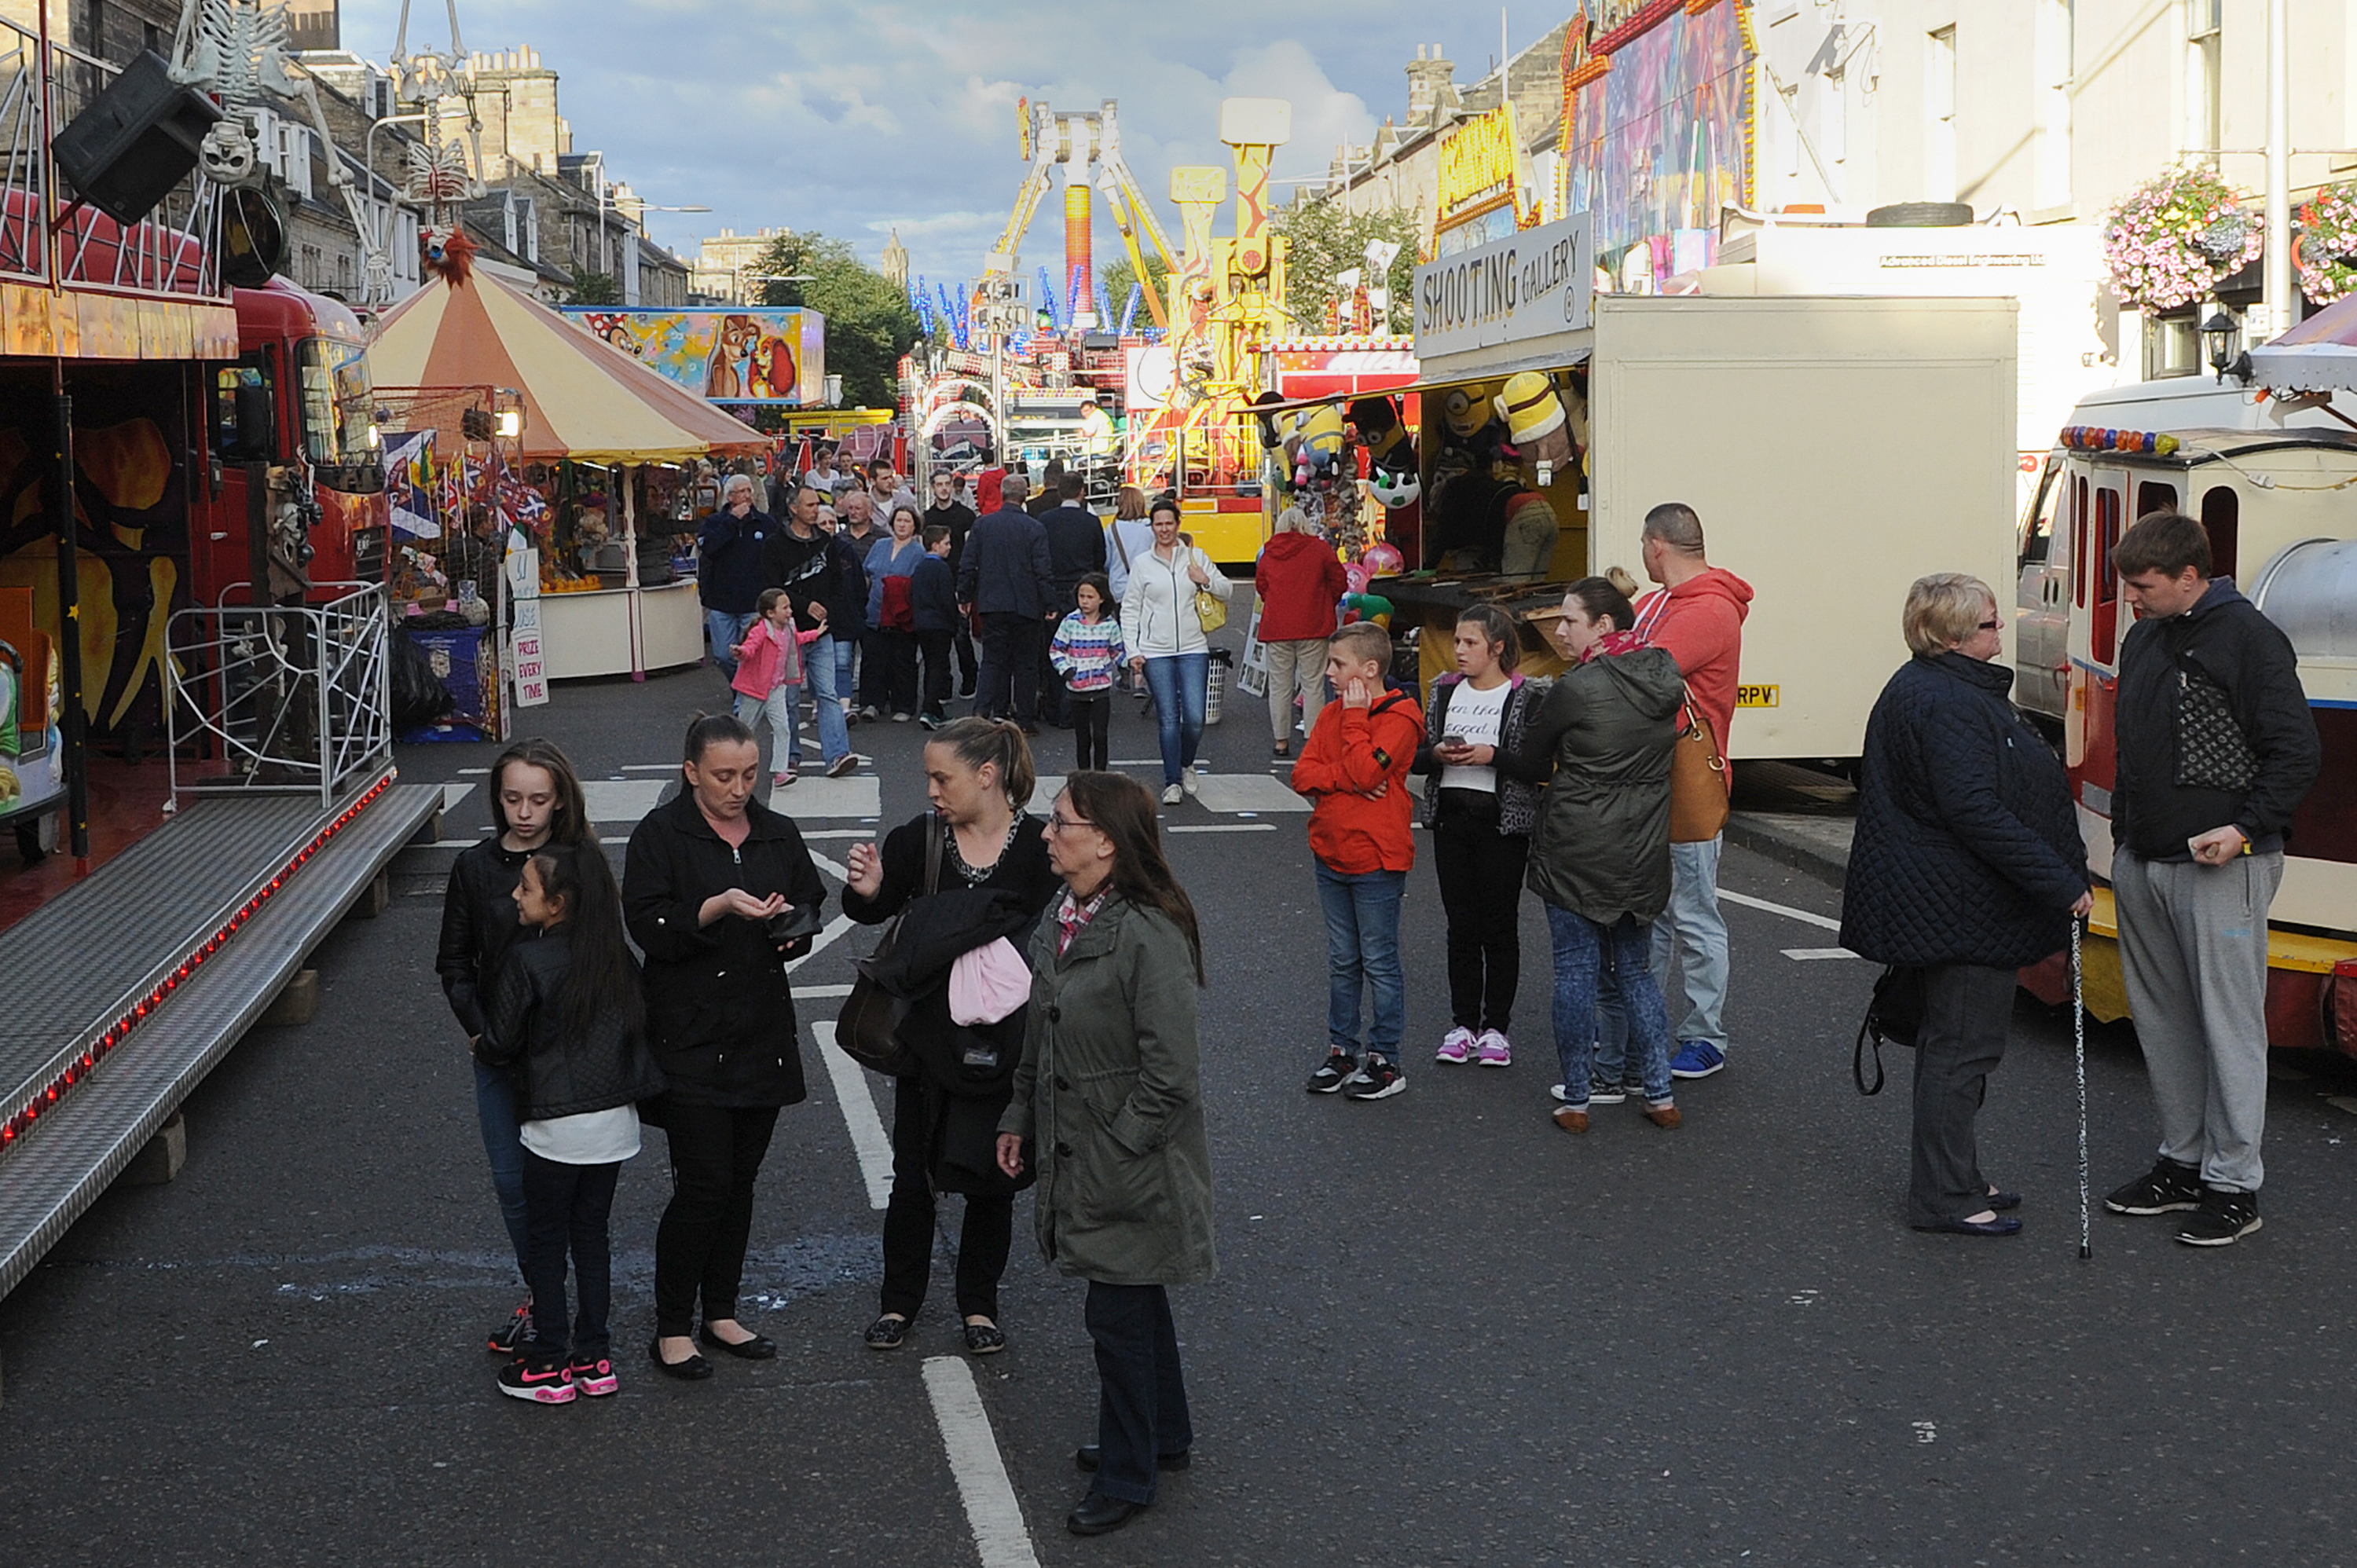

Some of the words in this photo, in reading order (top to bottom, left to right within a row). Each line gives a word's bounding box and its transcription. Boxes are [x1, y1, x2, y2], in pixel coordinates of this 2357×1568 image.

[1422, 248, 1516, 336] SHOOTING
[1522, 229, 1579, 306] GALLERY
[518, 639, 540, 657] PRIZE
[519, 661, 542, 680] EVERY
[522, 682, 543, 700] TIME
